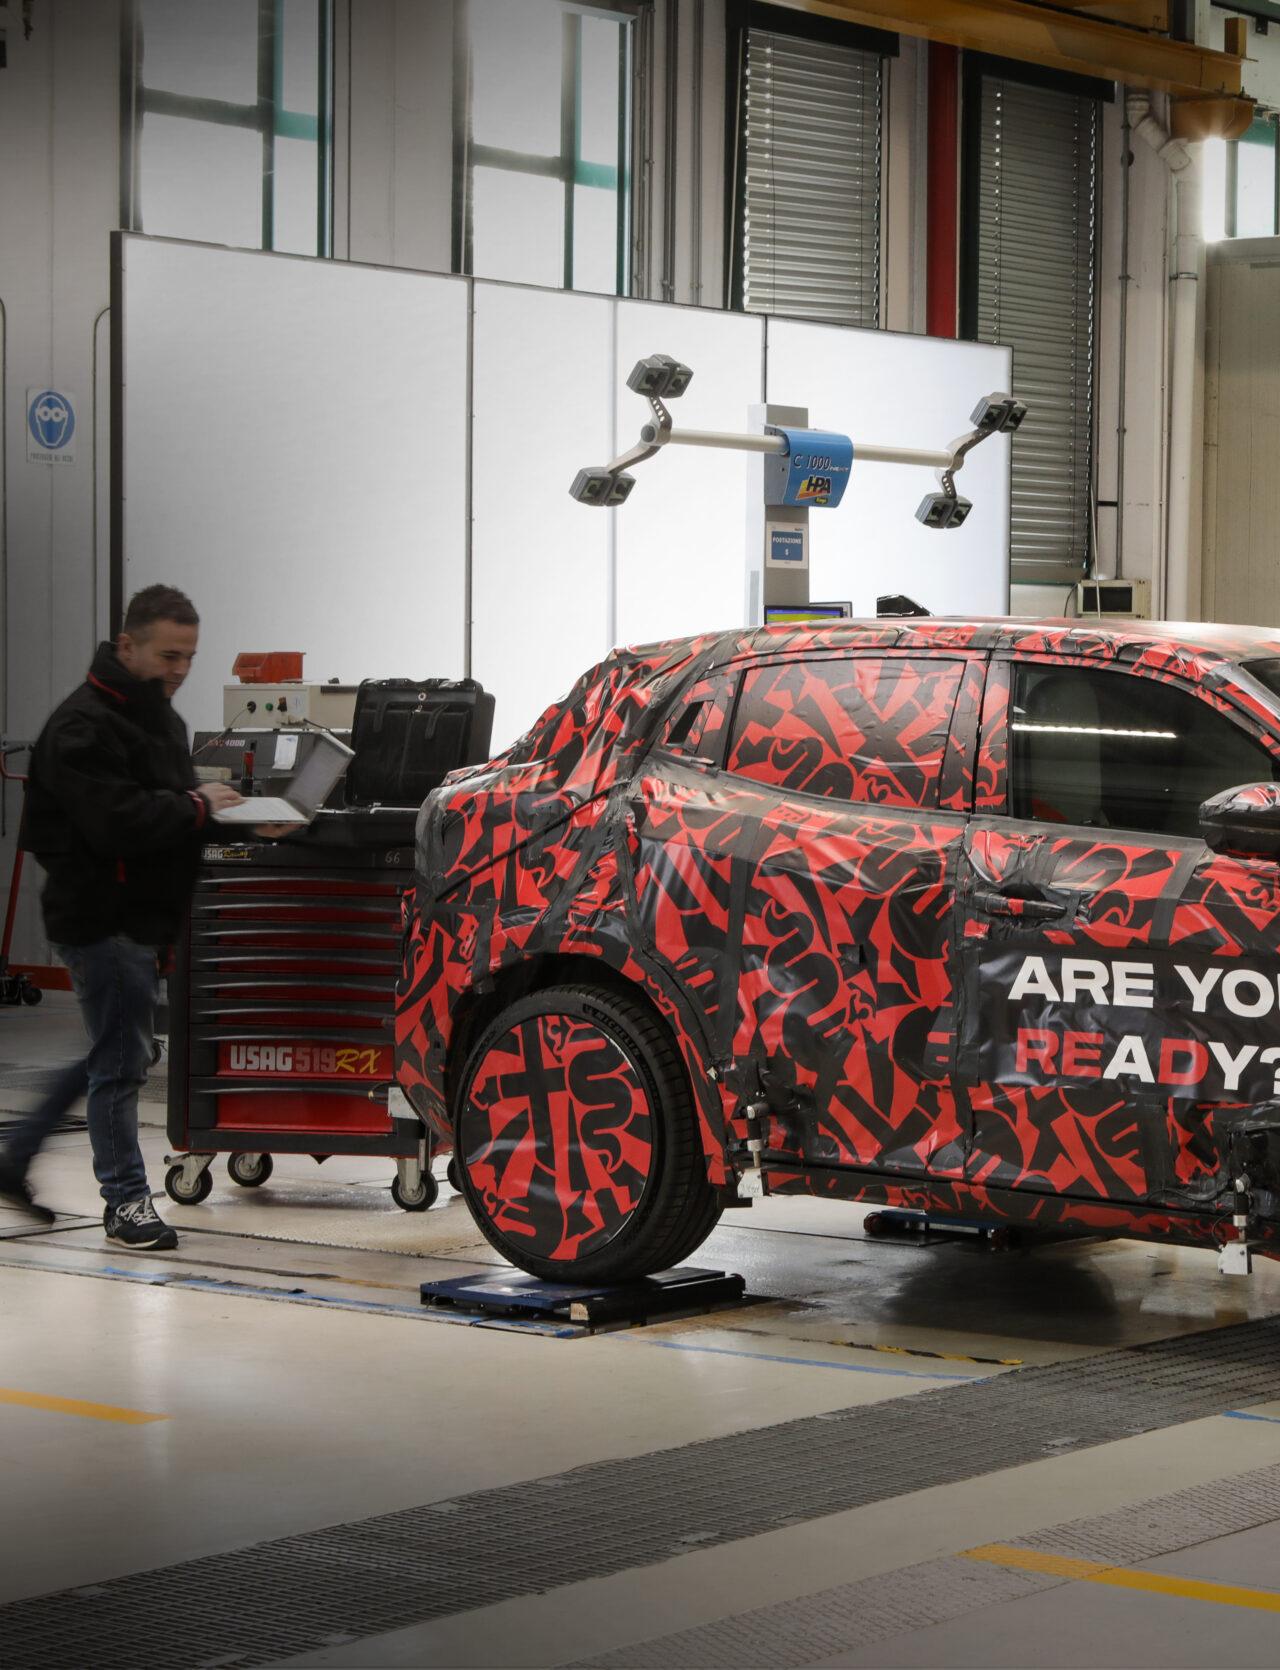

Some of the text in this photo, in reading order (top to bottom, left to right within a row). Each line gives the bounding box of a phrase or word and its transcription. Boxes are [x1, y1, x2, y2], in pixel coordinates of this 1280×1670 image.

[794, 454, 804, 469] C
[806, 455, 832, 470] 1000
[1007, 955, 1154, 1009] ARE
[594, 1010, 640, 1056] MICHELIN
[230, 1044, 293, 1072] USAG
